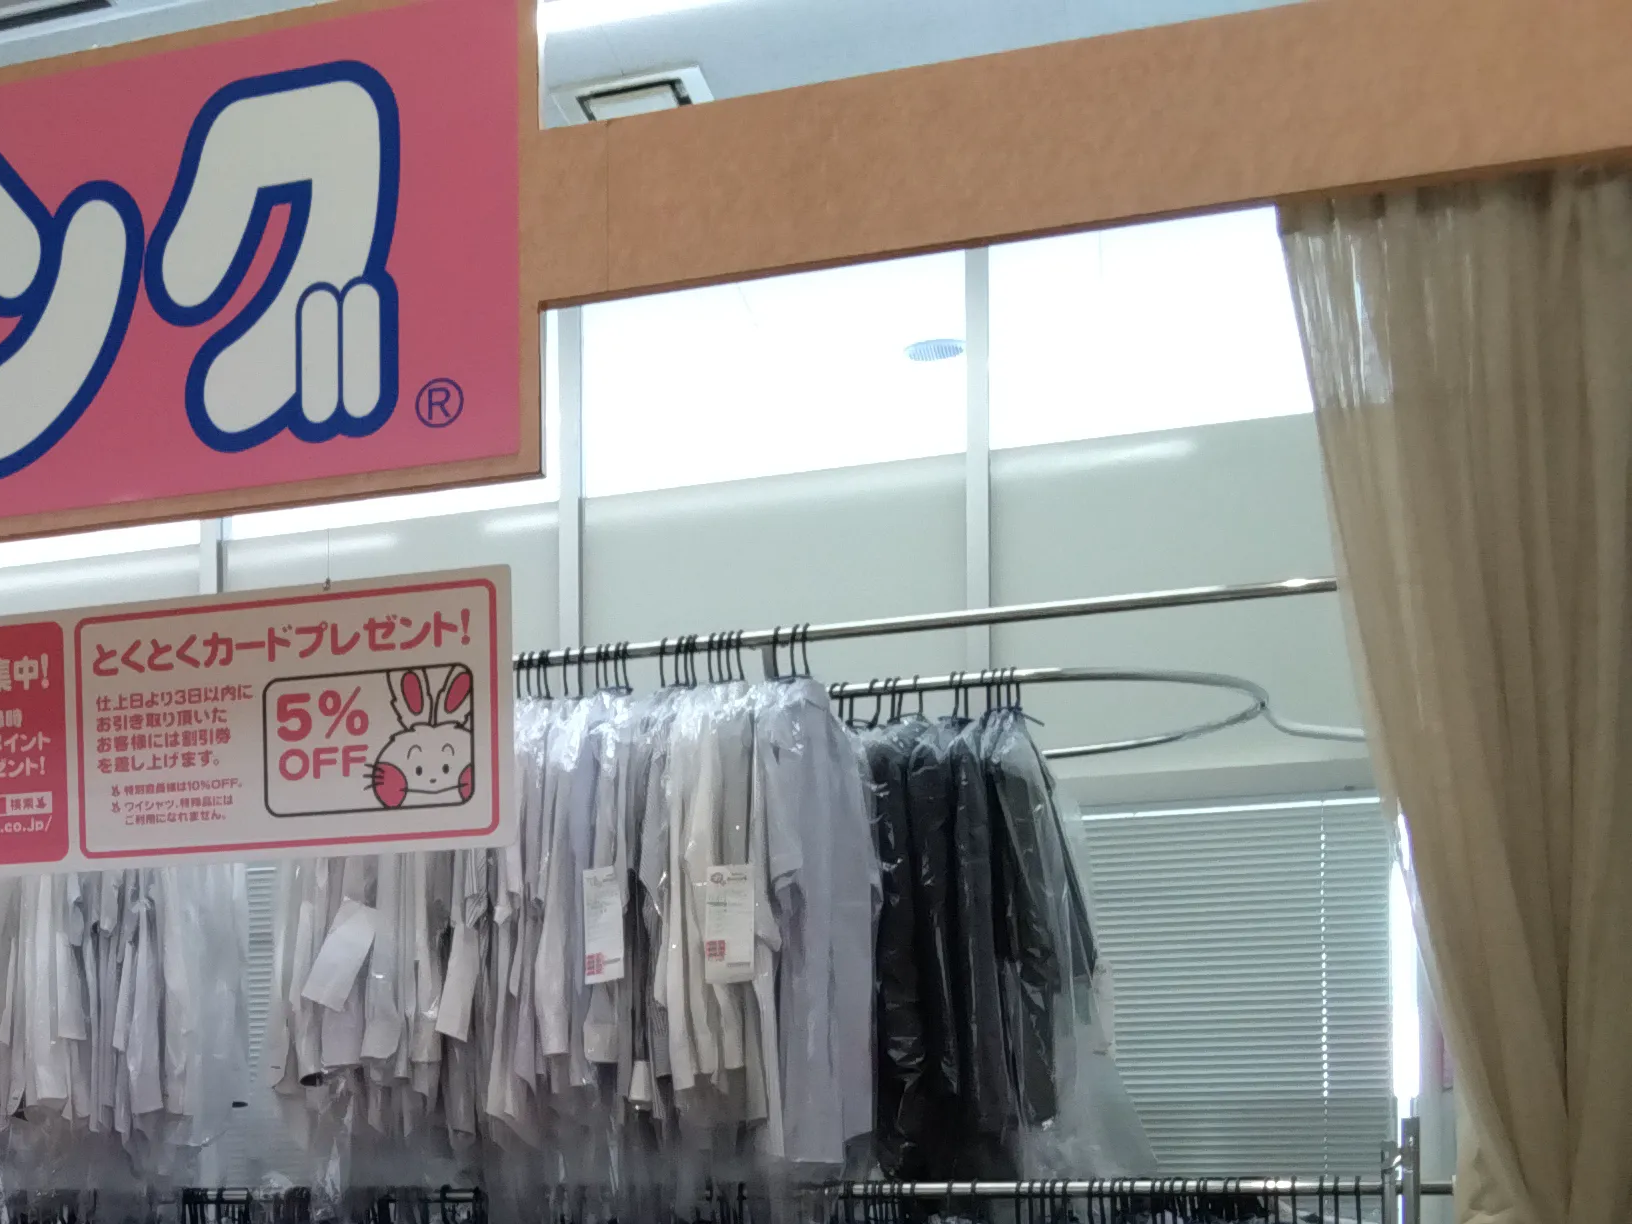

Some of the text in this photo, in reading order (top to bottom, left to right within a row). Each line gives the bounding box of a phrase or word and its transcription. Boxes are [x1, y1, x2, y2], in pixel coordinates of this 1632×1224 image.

[92, 609, 470, 677] とくとくカードプレゼント!
[96, 684, 253, 711] 仕上日より3日以内に
[96, 708, 227, 733] お引き取り頂いた
[276, 686, 369, 742] 5%
[96, 729, 231, 753] お客様には割引券
[97, 750, 220, 774] を差し上げます。
[278, 744, 369, 781] OFF
